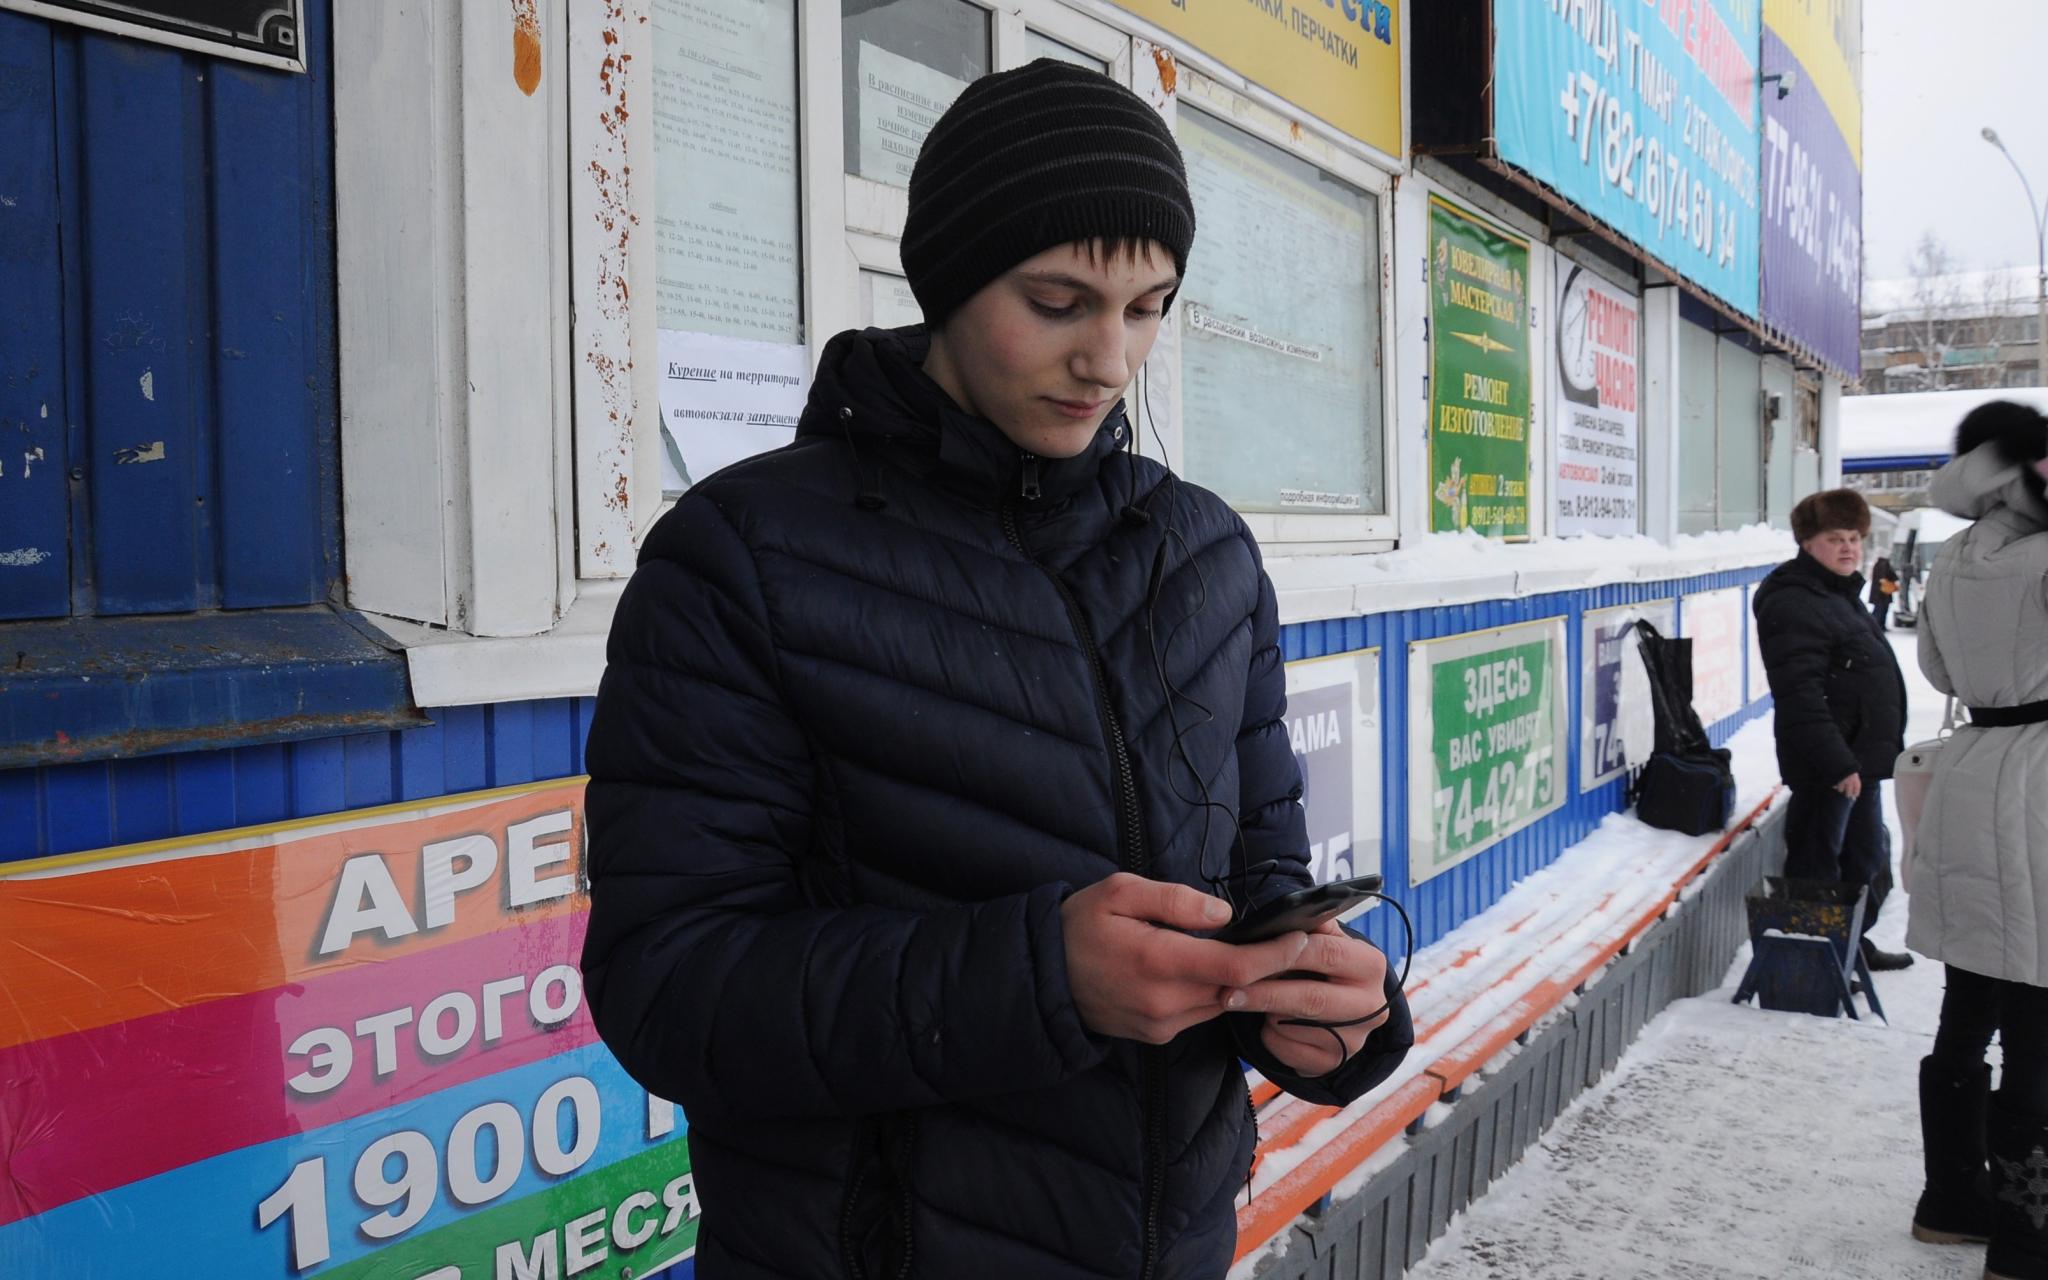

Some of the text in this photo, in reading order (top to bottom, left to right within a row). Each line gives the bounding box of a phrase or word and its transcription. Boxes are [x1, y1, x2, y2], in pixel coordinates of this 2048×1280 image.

[1291, 7, 1359, 68] ПЕРЧАТКИ
[1451, 246, 1512, 292] ЮВЕЛИРНАЯ
[1193, 310, 1200, 324] В
[1450, 280, 1515, 324] МАСТЕРСКАЯ
[1587, 287, 1637, 359] РЕМОНТ
[667, 361, 800, 388] Курение на территории
[1463, 372, 1509, 406] РЕМОНТ
[1596, 351, 1635, 413] ЧАСОВ
[673, 407, 800, 428] автовокзала запрещено
[1440, 404, 1525, 442] ИЗГОТОВЛЕНИЕ
[1497, 474, 1505, 497] 2
[1464, 656, 1531, 719] ЗДЕСЬ
[1450, 710, 1542, 771] ВАС УВИДЯТ
[1434, 745, 1553, 856] 74-42-75
[319, 809, 590, 956] АРЕ
[287, 964, 583, 1094] ЭТОГО
[258, 1076, 602, 1271] 1900
